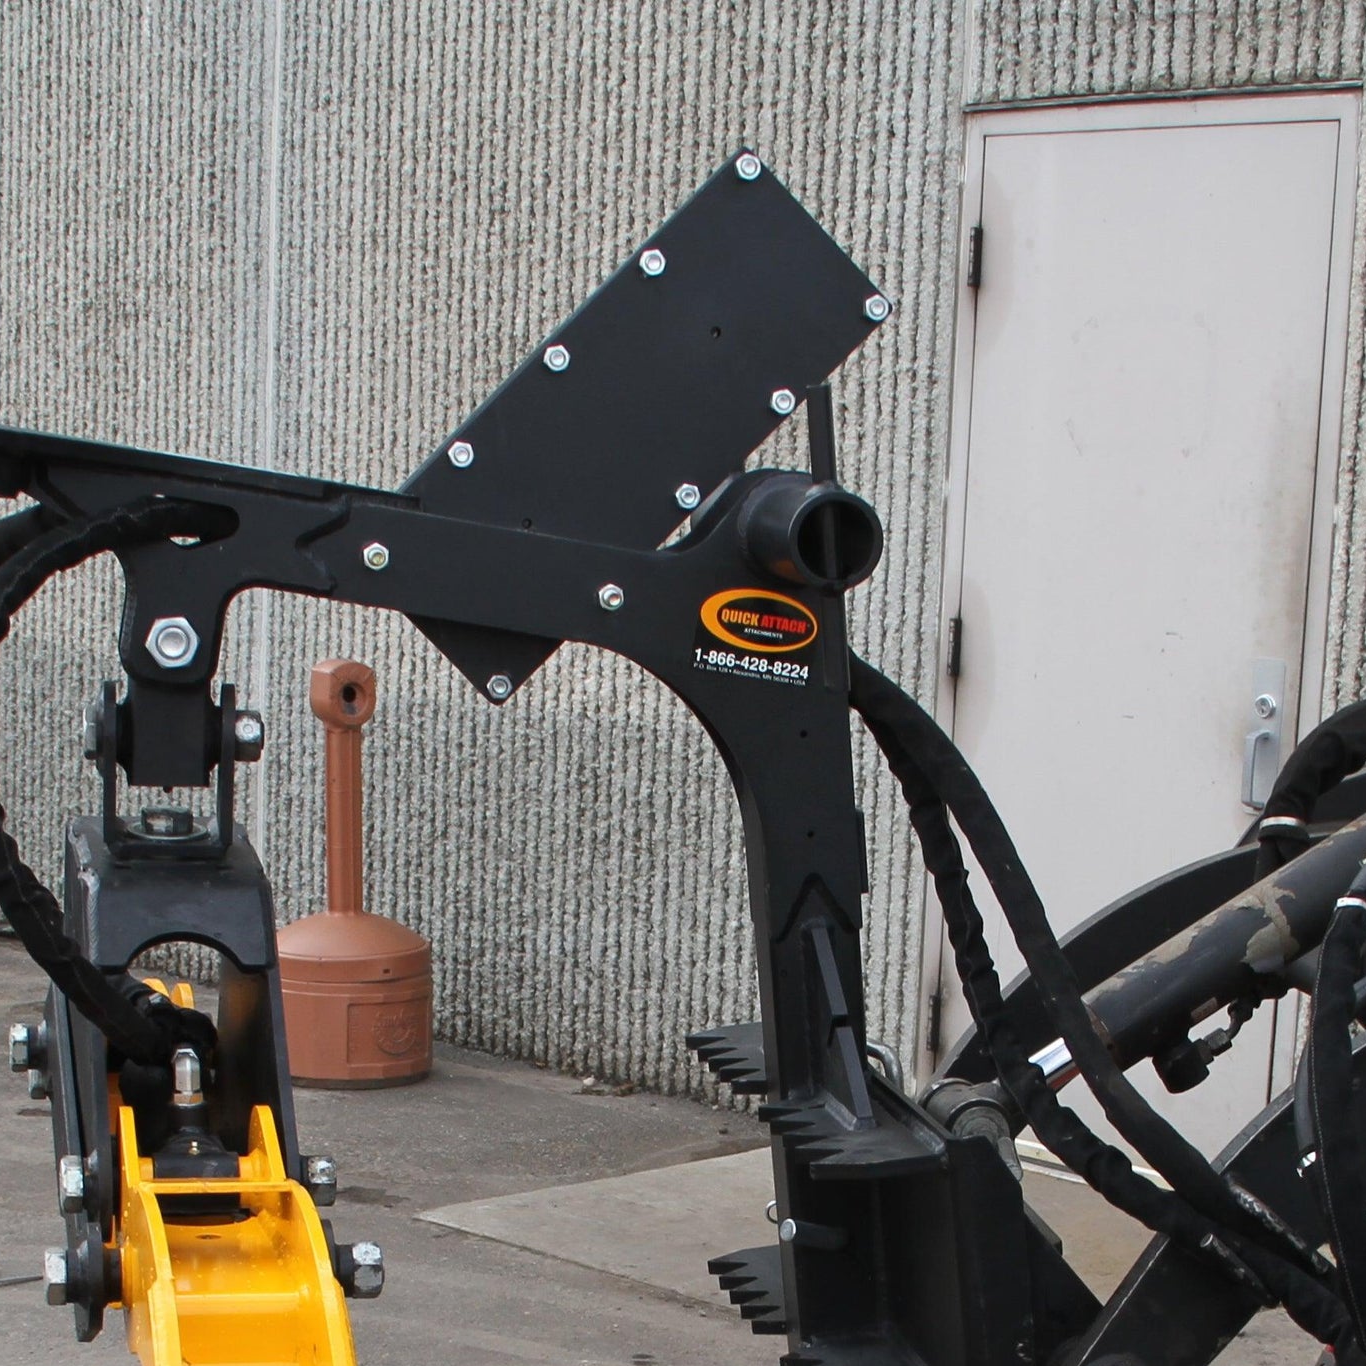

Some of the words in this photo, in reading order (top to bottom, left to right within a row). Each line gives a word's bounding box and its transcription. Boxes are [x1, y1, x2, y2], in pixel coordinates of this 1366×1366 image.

[721, 608, 760, 627] QUICK
[761, 614, 807, 634] ATTACH
[744, 627, 783, 639] ATTACHMENTS
[695, 648, 809, 680] 1-866-428-8224
